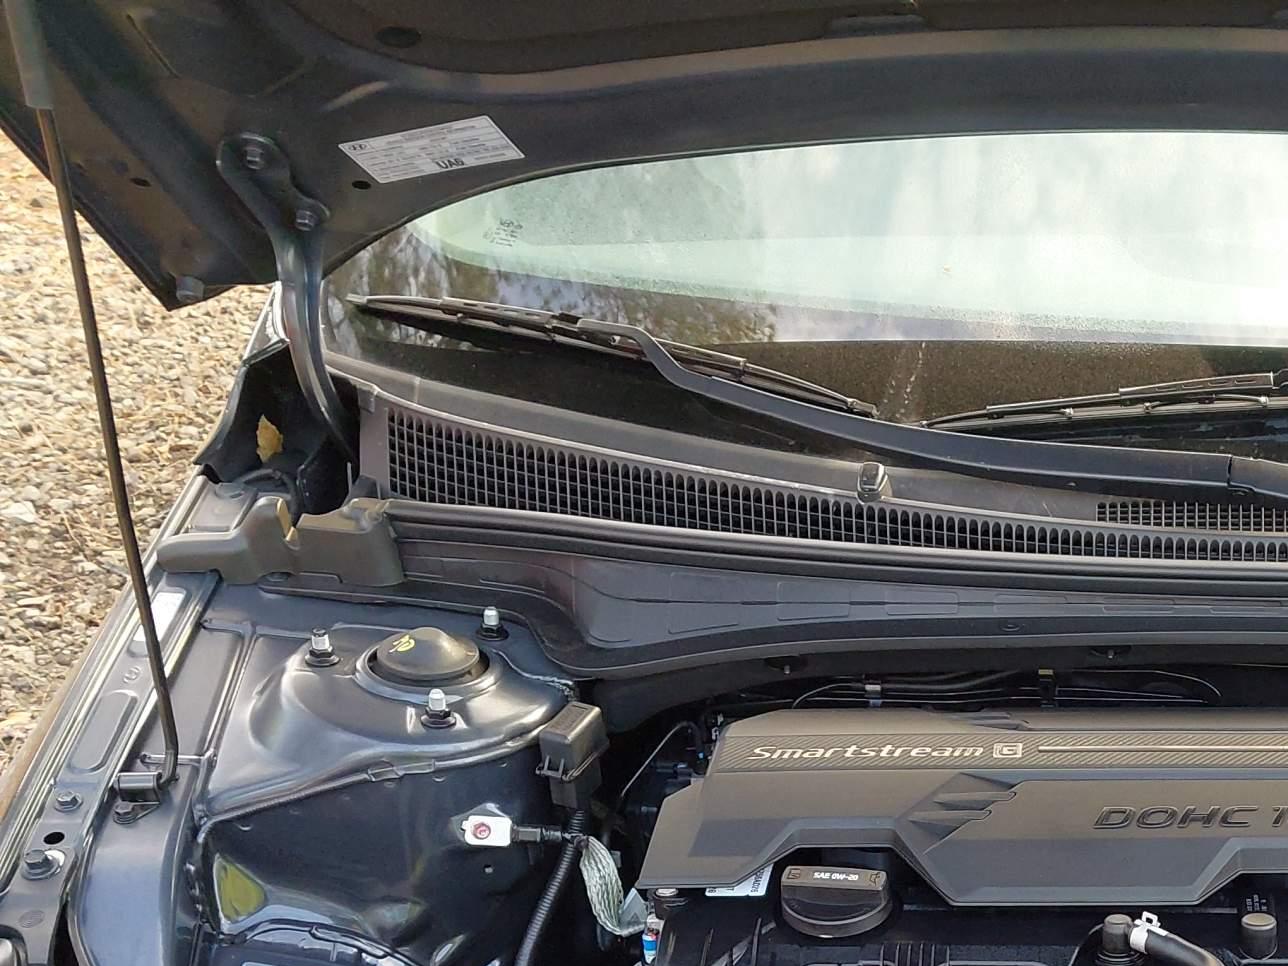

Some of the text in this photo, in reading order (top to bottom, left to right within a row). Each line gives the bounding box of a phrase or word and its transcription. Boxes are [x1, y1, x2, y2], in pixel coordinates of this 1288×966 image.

[748, 744, 984, 760] Smartstream
[1093, 805, 1259, 829] DOHC
[813, 871, 860, 881] SAE 0W-20
